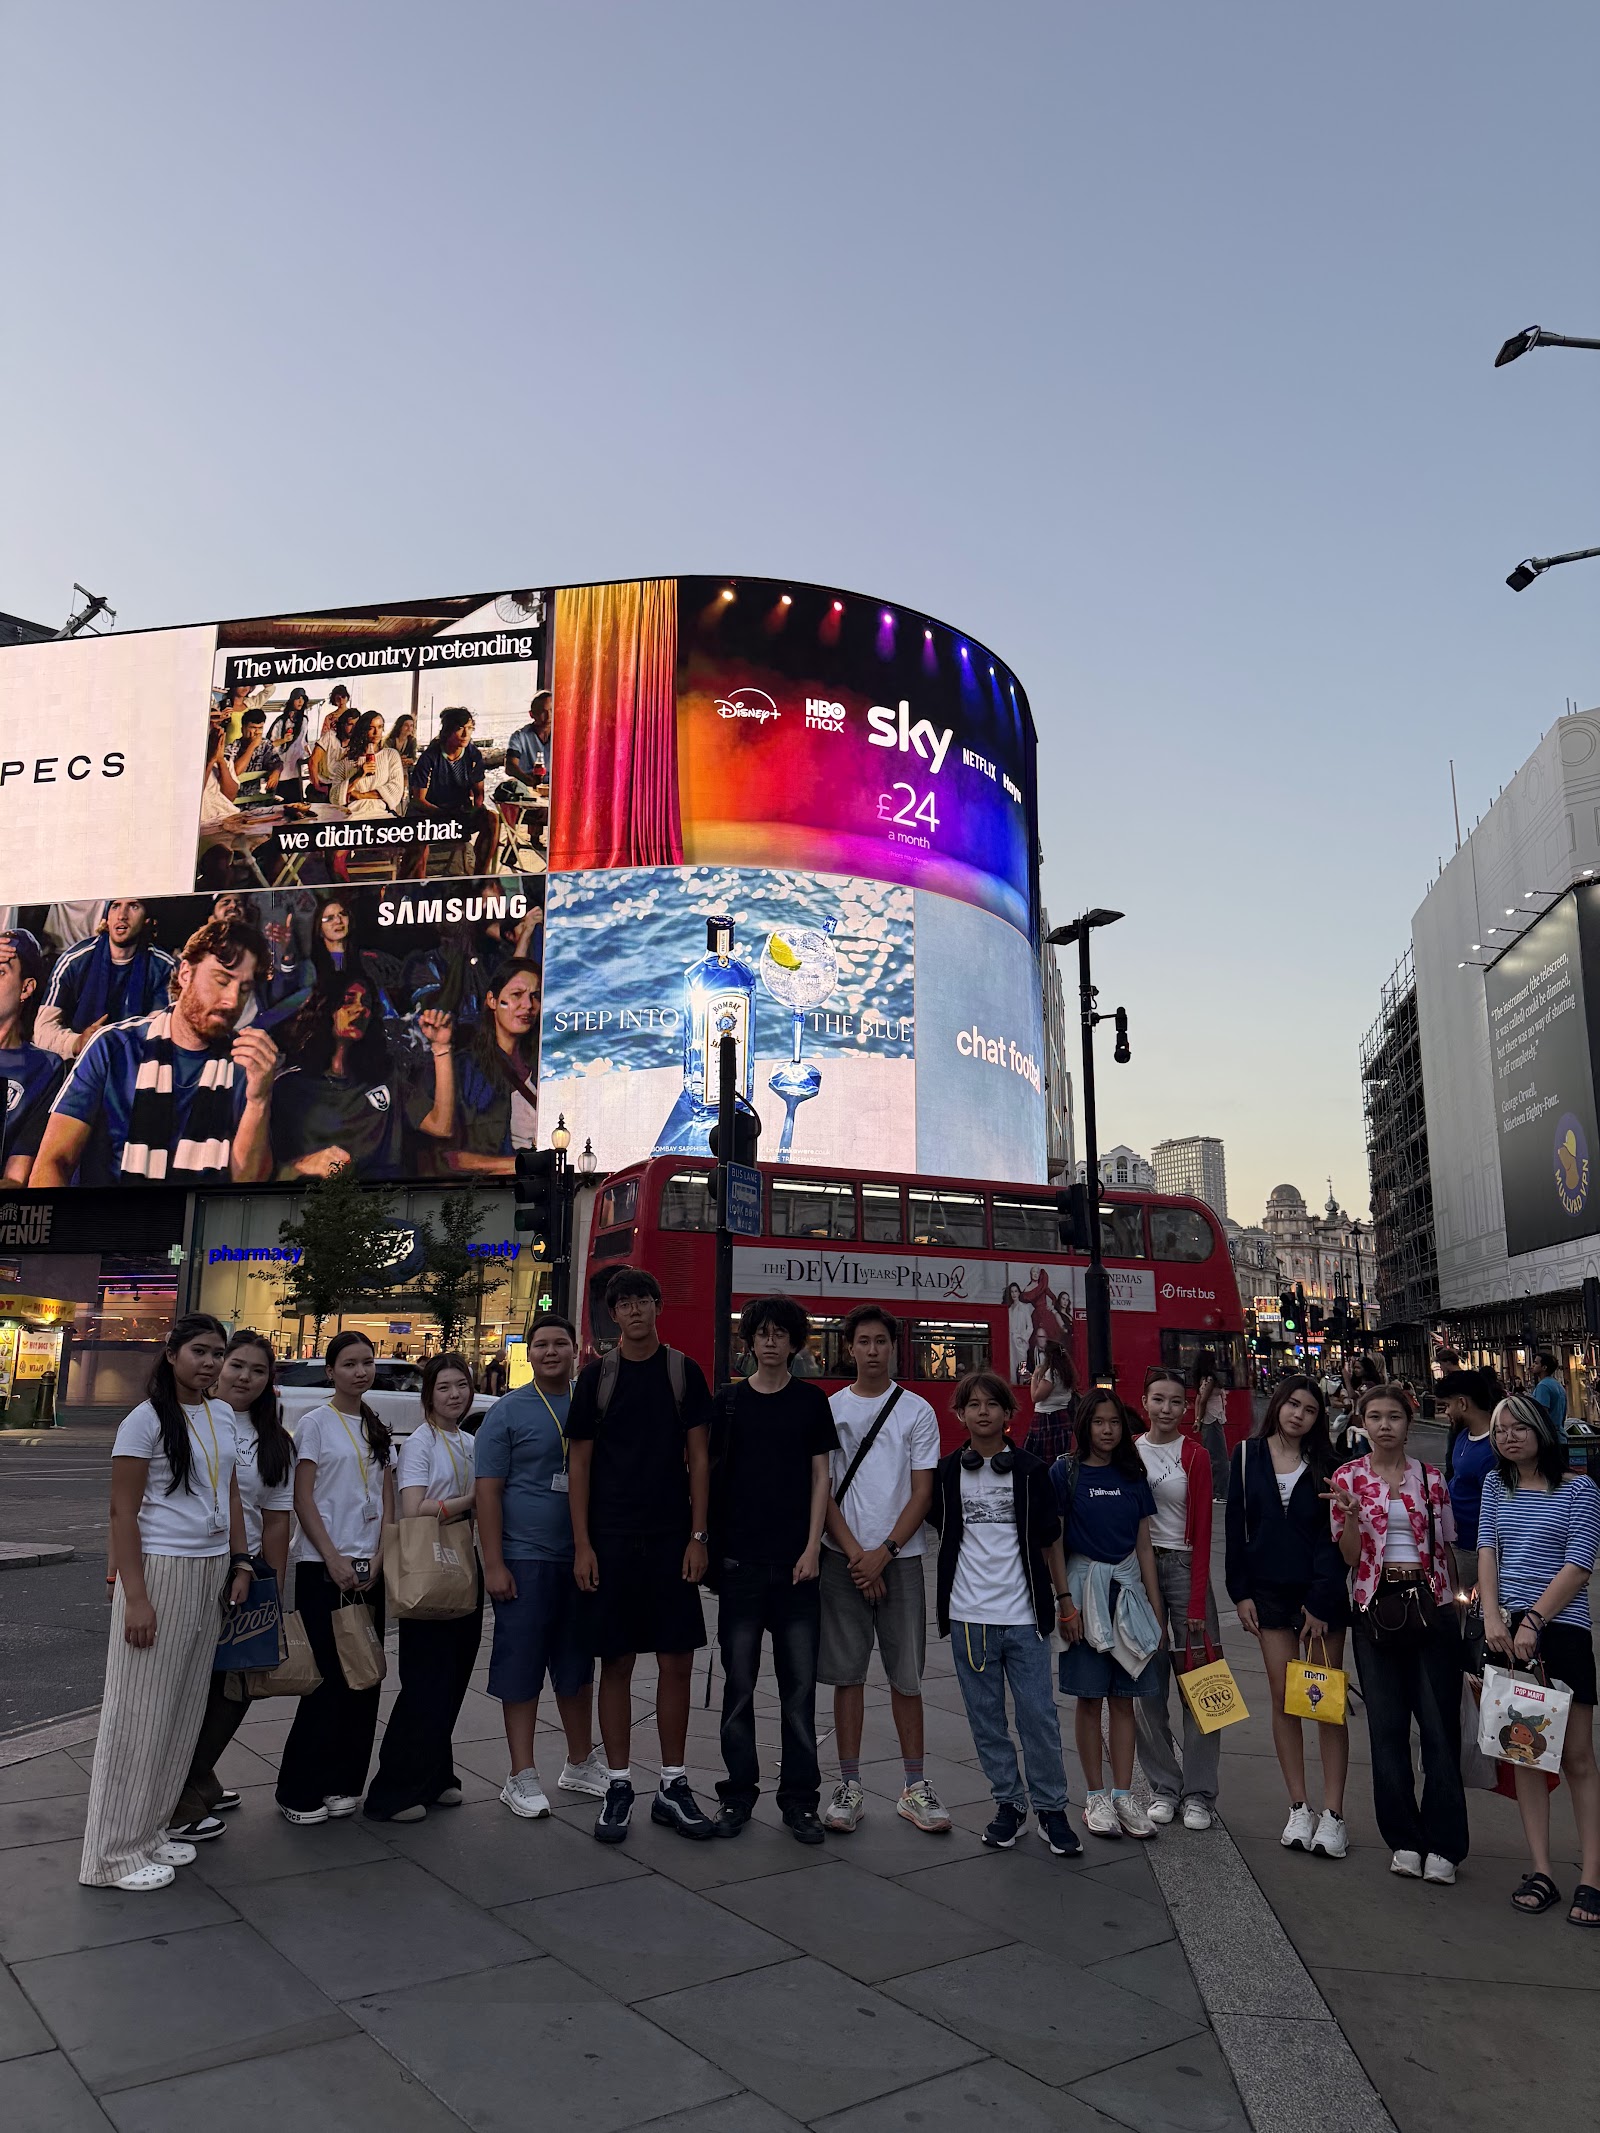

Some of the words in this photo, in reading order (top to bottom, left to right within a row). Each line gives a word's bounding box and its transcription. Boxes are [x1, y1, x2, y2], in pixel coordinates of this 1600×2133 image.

[233, 656, 271, 680] The
[273, 651, 335, 677] whole
[336, 648, 416, 669] country
[417, 634, 534, 669] pretending
[713, 698, 782, 725] Disney+
[805, 697, 846, 721] HBO
[805, 715, 845, 734] max
[866, 699, 954, 775] sky
[0, 751, 126, 787] PECS
[962, 747, 997, 783] NETFLIX
[876, 781, 941, 833] £24
[278, 832, 309, 851] we
[315, 823, 375, 848] didn't
[375, 824, 415, 844] see
[416, 818, 463, 842] that:
[887, 830, 896, 841] a
[897, 832, 931, 849] month
[377, 893, 528, 927] SAMSUNG
[1502, 983, 1530, 1015] instrument
[1539, 952, 1569, 983] telescreen,
[1499, 1023, 1510, 1036] was
[1525, 994, 1540, 1018] could
[1539, 992, 1547, 1007] be
[1546, 970, 1571, 1001] dimmed,
[553, 1010, 613, 1032] STEP
[619, 1008, 680, 1030] INTO
[809, 1012, 854, 1037] THE
[860, 1016, 912, 1043] BLUE
[1505, 1038, 1519, 1056] there
[1517, 1029, 1528, 1045] was
[1527, 1025, 1535, 1039] no
[1534, 1016, 1546, 1032] way
[1551, 993, 1576, 1020] shutting
[956, 1025, 1007, 1068] chat
[1501, 1097, 1519, 1114] George
[1503, 1111, 1526, 1134] Nineteen
[731, 1167, 743, 1179] BUS
[743, 1171, 758, 1184] LANE
[1554, 1168, 1583, 1215] MULLVAD
[1579, 1158, 1589, 1198] VPN
[20, 1204, 54, 1225] THE
[208, 1244, 304, 1265] pharmacy
[466, 1239, 522, 1261] eauty
[762, 1262, 786, 1275] THE
[785, 1255, 868, 1285] DEVIL
[859, 1267, 897, 1280] WEARS
[896, 1265, 964, 1290] PRADA
[1109, 1284, 1123, 1298] AY
[1176, 1285, 1197, 1299] first
[1198, 1287, 1216, 1300] bus
[218, 1599, 279, 1646] Boots
[1200, 1689, 1231, 1709] TWG
[1515, 1686, 1527, 1695] POP
[1527, 1689, 1544, 1700] MART
